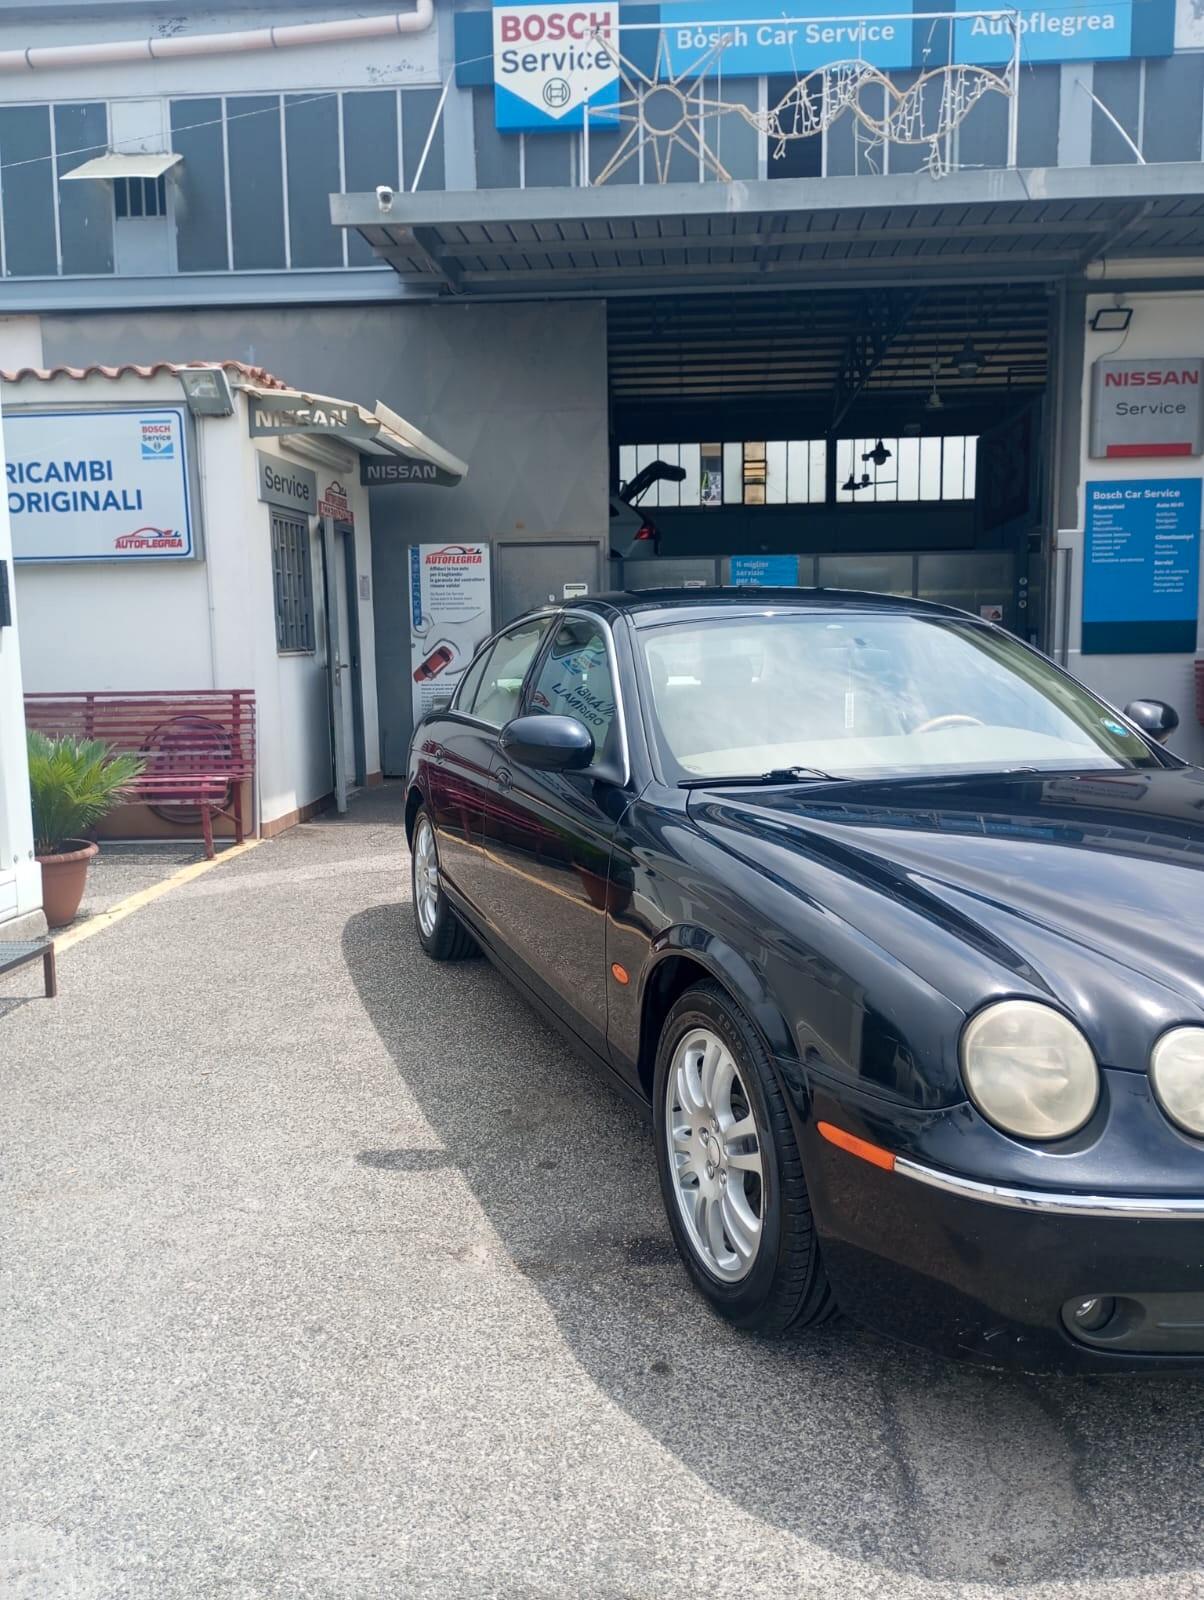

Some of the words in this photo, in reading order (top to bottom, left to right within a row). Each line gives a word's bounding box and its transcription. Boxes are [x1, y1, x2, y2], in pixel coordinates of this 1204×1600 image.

[501, 12, 611, 43] BOSCH
[970, 12, 1116, 37] Autoflegrea
[677, 26, 748, 49] Bosch
[756, 26, 798, 46] Car
[805, 21, 895, 44] Service
[501, 45, 611, 73] Service
[1105, 370, 1199, 387] NISSAN
[1115, 402, 1187, 416] Service
[142, 425, 171, 434] BOSCH
[142, 433, 172, 441] Service
[367, 465, 438, 479] NISSAN
[264, 466, 310, 501] Service
[8, 489, 143, 514] ORIGINALI
[1093, 491, 1123, 500] Bosch
[1125, 490, 1142, 499] Car
[1144, 488, 1181, 499] Service
[115, 538, 183, 550] AUTOFLEGREA
